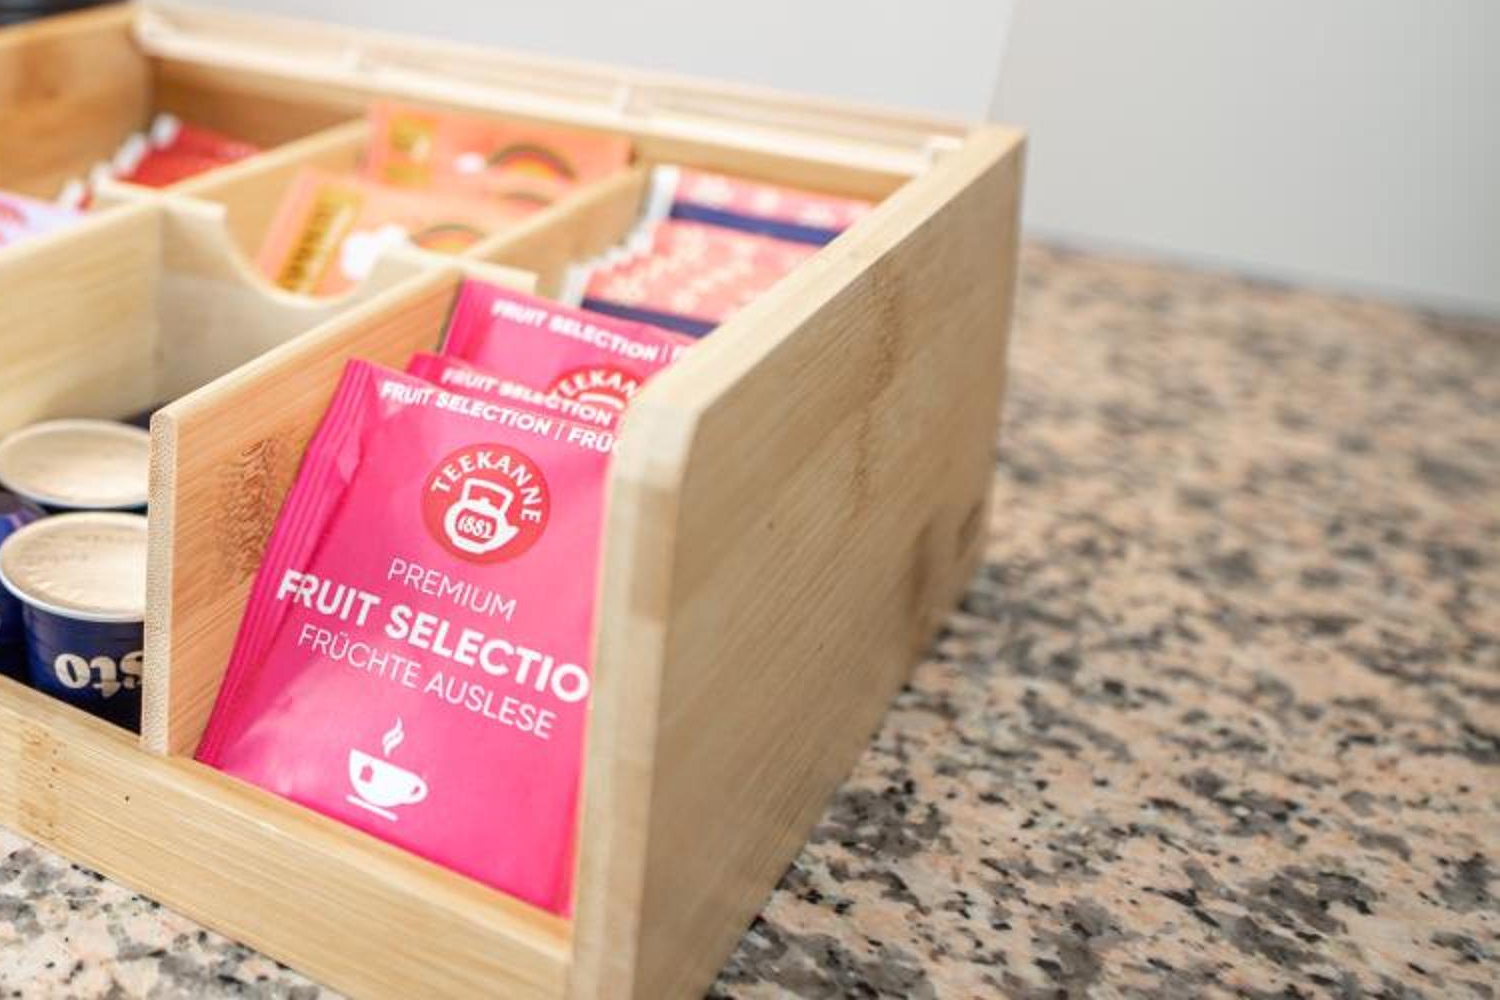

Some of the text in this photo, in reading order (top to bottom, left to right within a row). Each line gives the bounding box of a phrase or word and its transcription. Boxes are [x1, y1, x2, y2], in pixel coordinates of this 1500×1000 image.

[490, 300, 547, 328] FRUIT
[549, 315, 659, 361] SELECTION
[380, 381, 433, 406] FRUIT
[435, 392, 552, 436] SELECTION
[441, 367, 612, 426] FRUIT SELECTION
[431, 451, 543, 524] TEEKANNE
[276, 568, 380, 627] FRUIT
[387, 558, 517, 622] PREMIUM
[298, 622, 557, 740] FRÜCHTE AUSLESE
